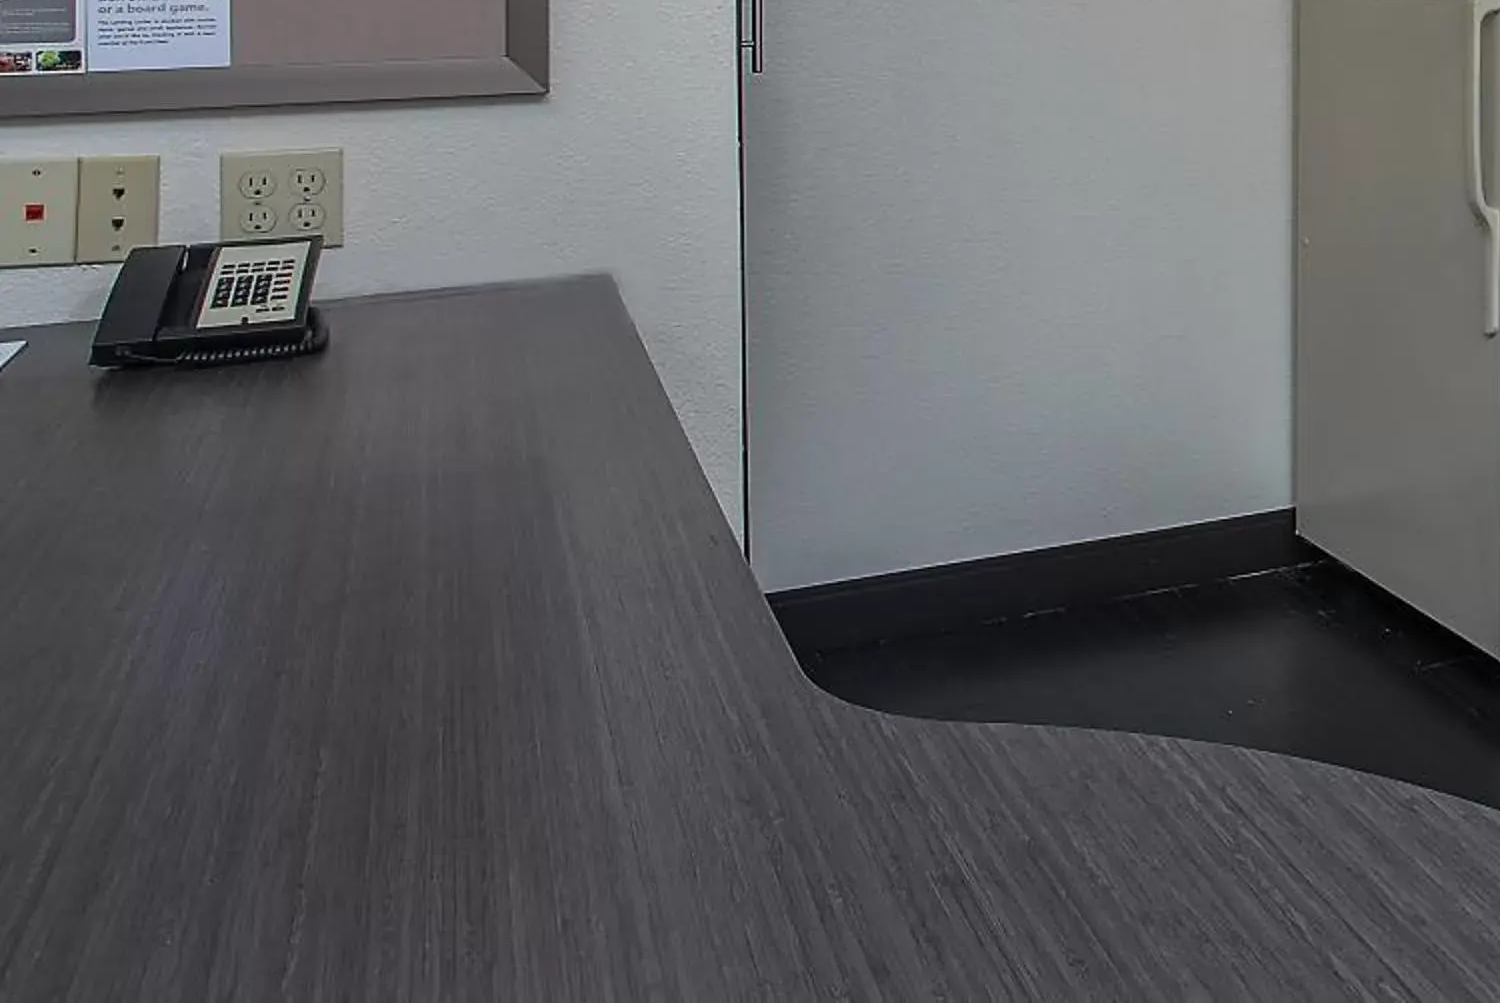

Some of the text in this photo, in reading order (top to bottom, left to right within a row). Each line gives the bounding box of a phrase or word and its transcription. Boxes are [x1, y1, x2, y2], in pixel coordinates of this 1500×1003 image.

[97, 3, 209, 15] or a board game.
